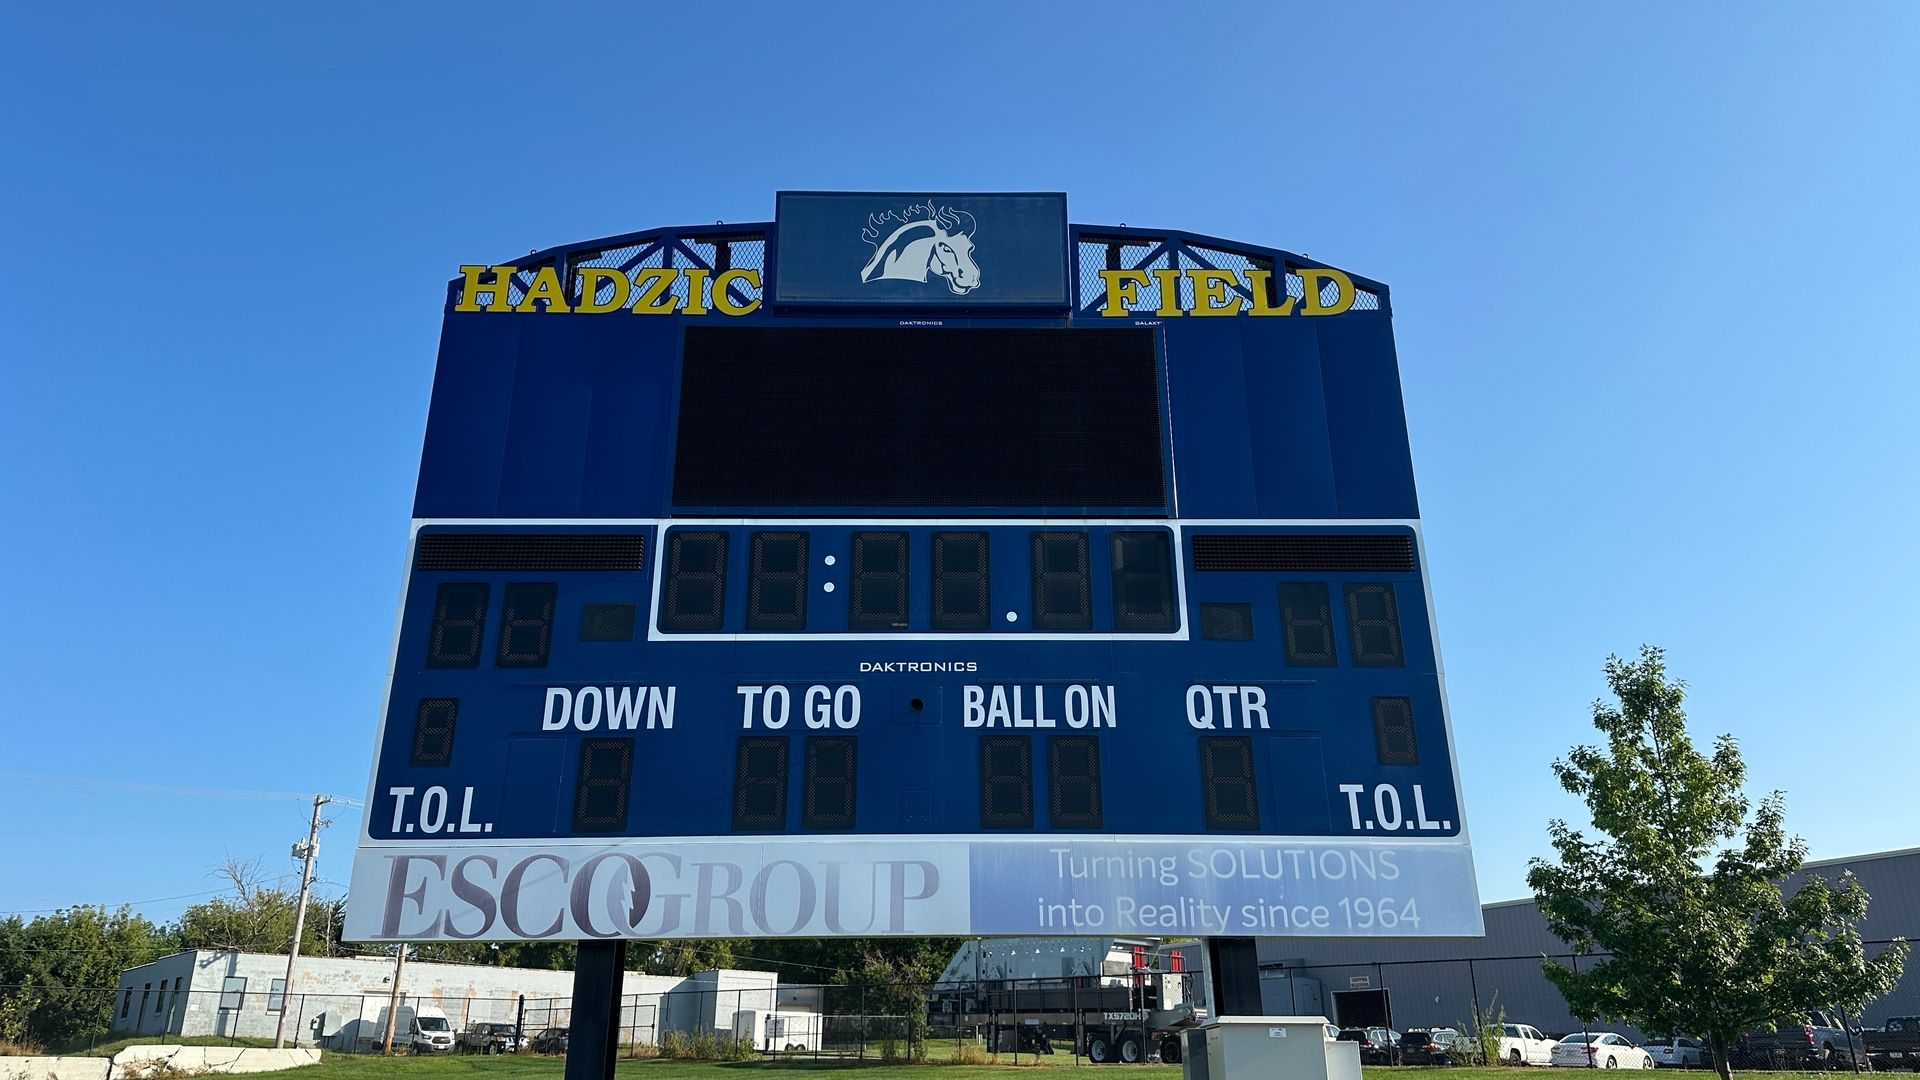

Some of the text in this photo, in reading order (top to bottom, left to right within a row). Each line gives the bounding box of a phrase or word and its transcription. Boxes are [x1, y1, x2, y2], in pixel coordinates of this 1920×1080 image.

[455, 265, 763, 315] HADZIC
[1099, 269, 1356, 317] FIELD
[859, 662, 978, 672] DAKTRONICS
[542, 686, 677, 731] DOWN
[737, 684, 861, 729] TO GO
[963, 685, 1117, 728] BALL ON
[1186, 685, 1271, 729] QTR
[388, 786, 494, 833] T.O.L.
[1339, 784, 1451, 831] T.O.L.
[1049, 848, 1400, 886] Turning SOLUTIONS
[1038, 897, 1421, 932] into Reality since 1964
